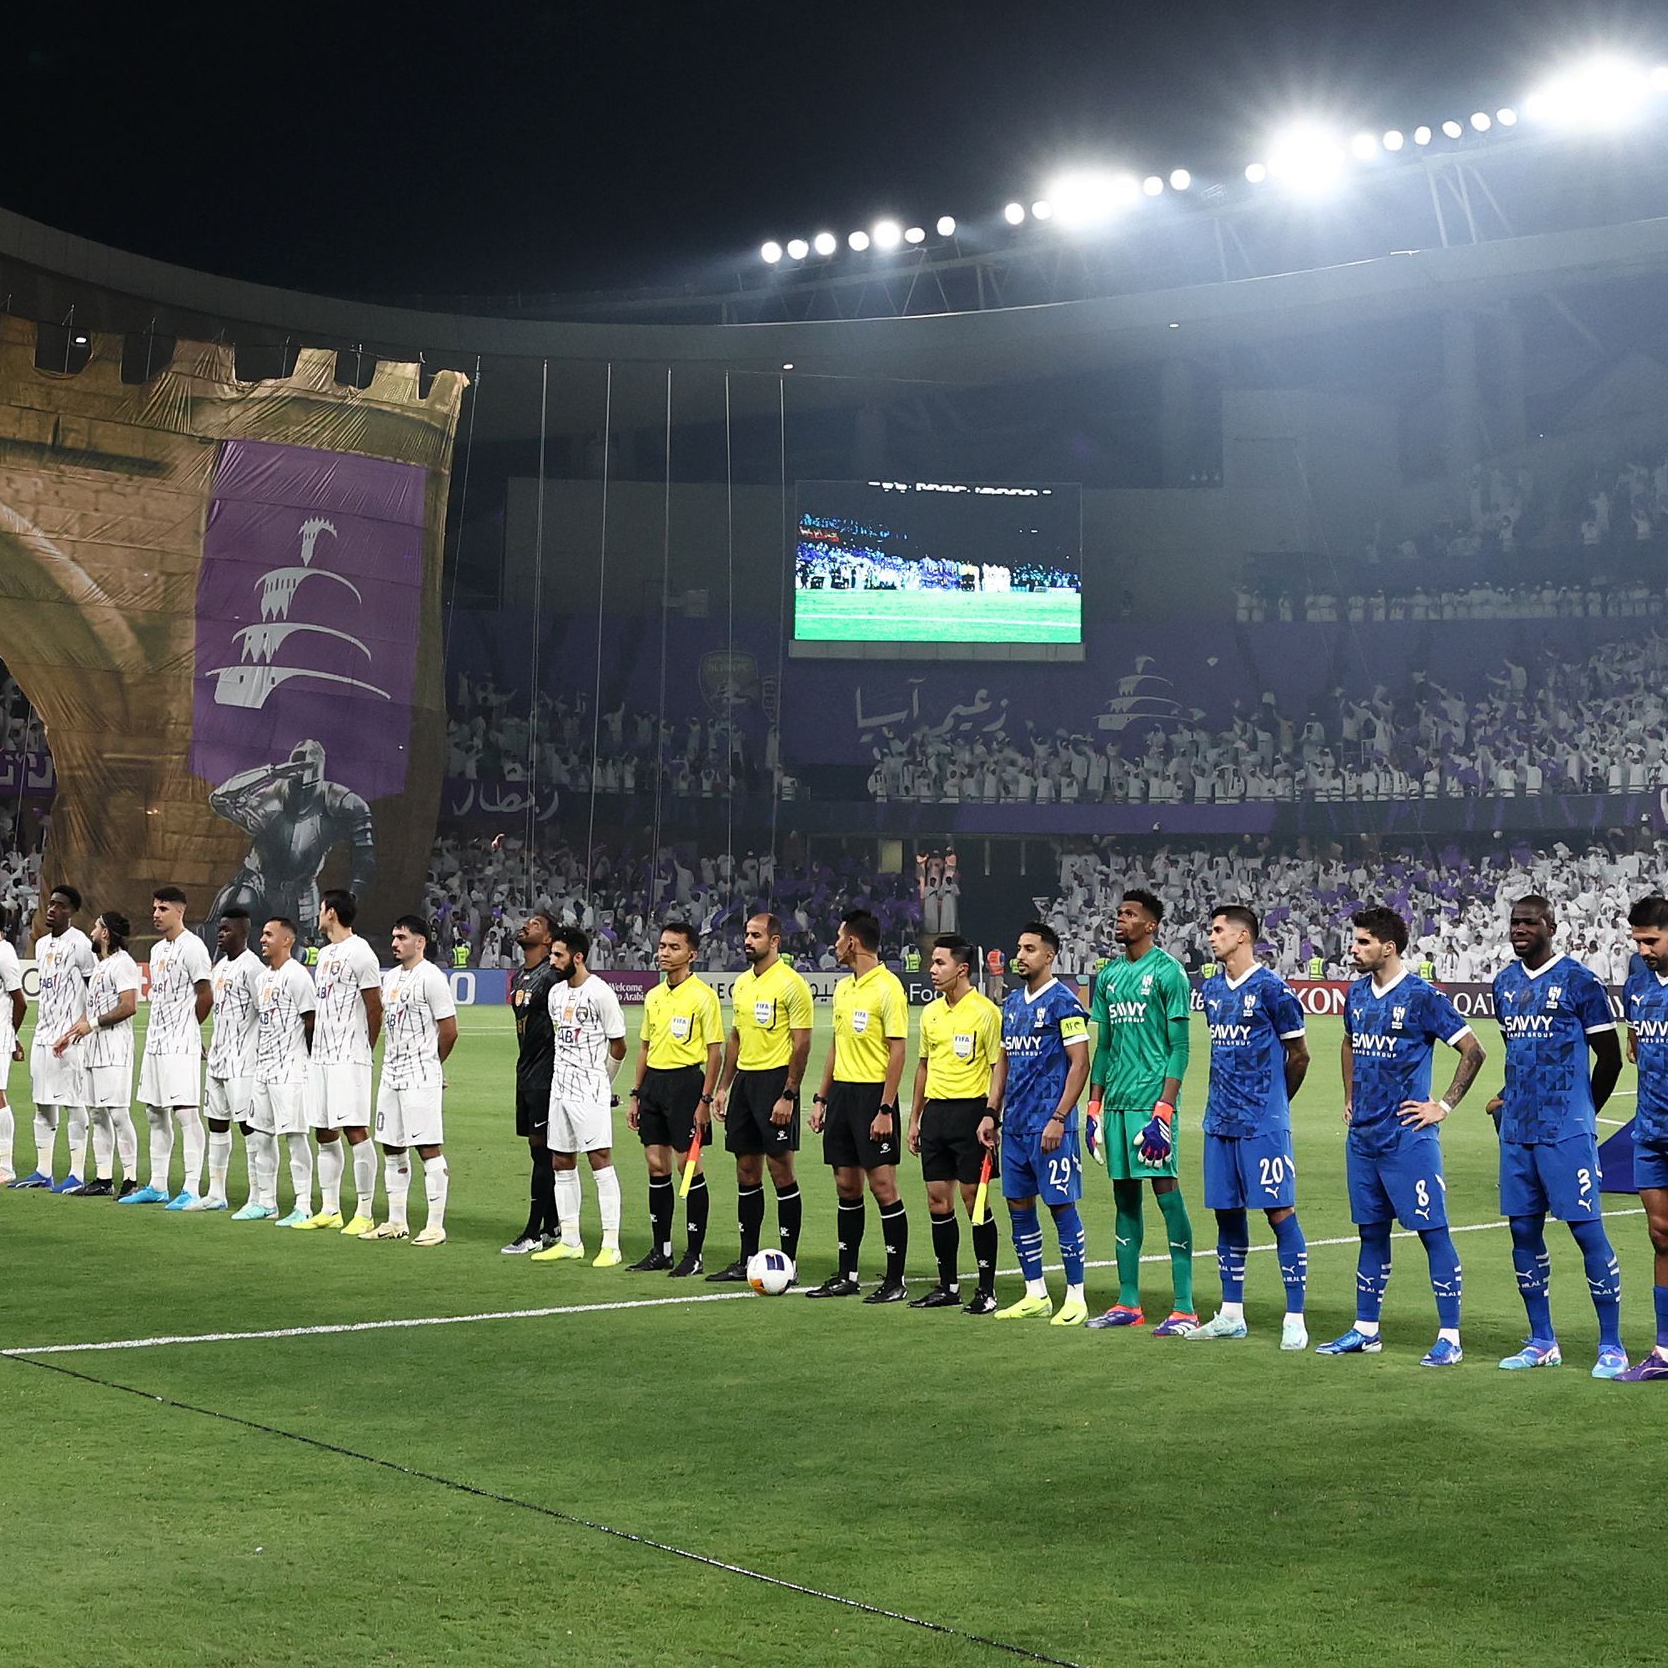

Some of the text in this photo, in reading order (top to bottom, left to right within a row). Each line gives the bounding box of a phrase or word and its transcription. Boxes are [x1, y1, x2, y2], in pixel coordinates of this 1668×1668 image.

[623, 992, 647, 1001] Arabi
[1210, 1024, 1251, 1040] SAVVY
[1504, 1015, 1554, 1031] SAVVY
[955, 1035, 970, 1043] FIFA
[1005, 1035, 1042, 1050] SAVVY
[1352, 1032, 1397, 1052] SAVVY
[1048, 1157, 1071, 1185] 29
[1259, 1158, 1284, 1185] 20
[1577, 1168, 1592, 1197] 3
[1415, 1179, 1430, 1206] 8
